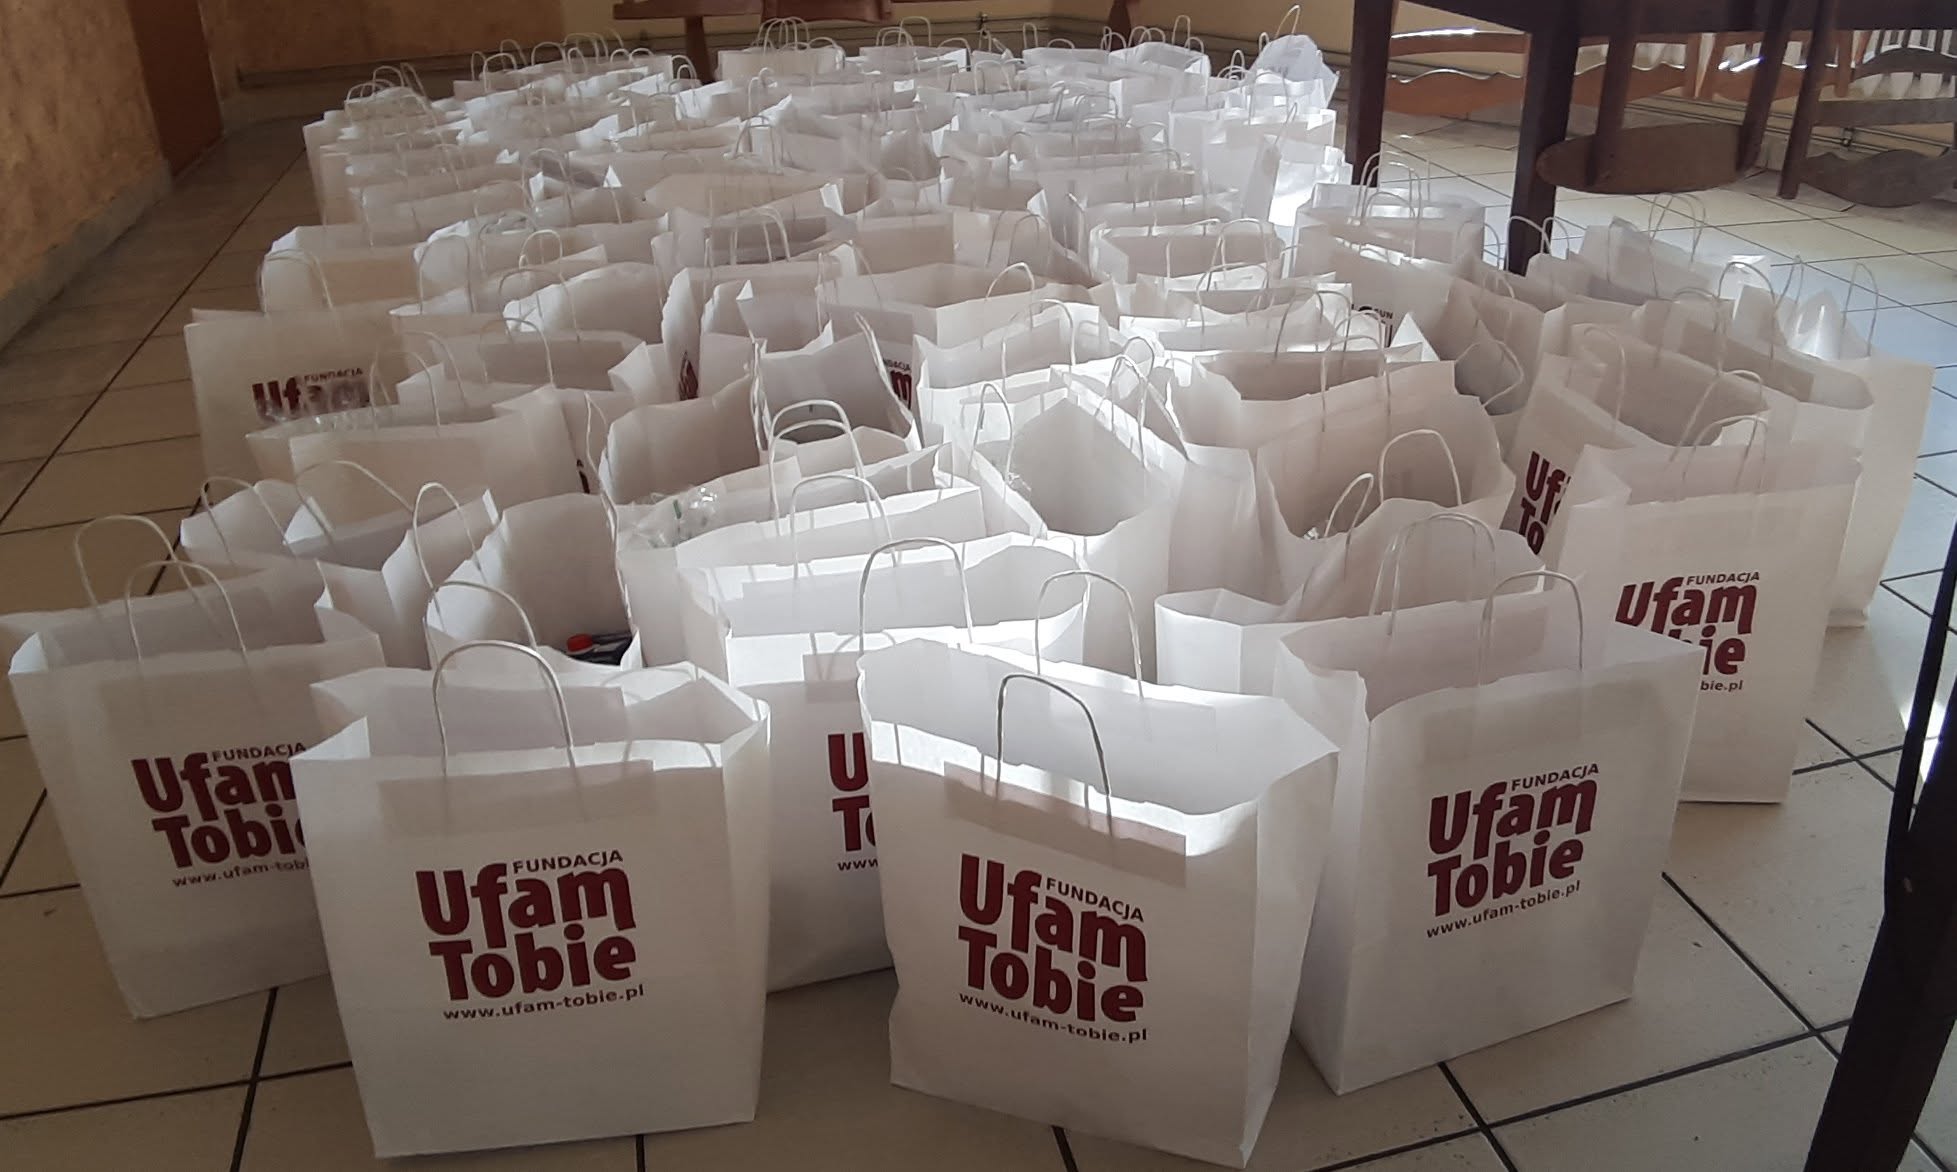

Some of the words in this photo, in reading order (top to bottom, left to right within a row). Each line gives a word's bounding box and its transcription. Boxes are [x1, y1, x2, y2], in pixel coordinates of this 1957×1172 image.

[1526, 450, 1566, 525] Uf
[1615, 576, 1757, 635] Ufam
[1687, 571, 1760, 586] FUNDACJA
[211, 742, 306, 763] FUNDACJA
[1511, 763, 1599, 791] FUNDACJA
[152, 803, 307, 868] Tobi
[1429, 779, 1597, 860] Ufam
[513, 850, 623, 874] FUNDACJA
[1427, 829, 1584, 917] Tobie
[415, 863, 636, 949] Ufam
[960, 853, 1148, 982] Ufam
[1046, 877, 1144, 923] FUNDACJA
[1426, 880, 1580, 938] www.ufam-tobie.pl
[429, 923, 637, 1001] Tobie
[958, 925, 1144, 1023] Tobie
[443, 984, 644, 1021] www.ufam-tobie.pl
[959, 993, 1147, 1044] www.ufam-tobie.pl
